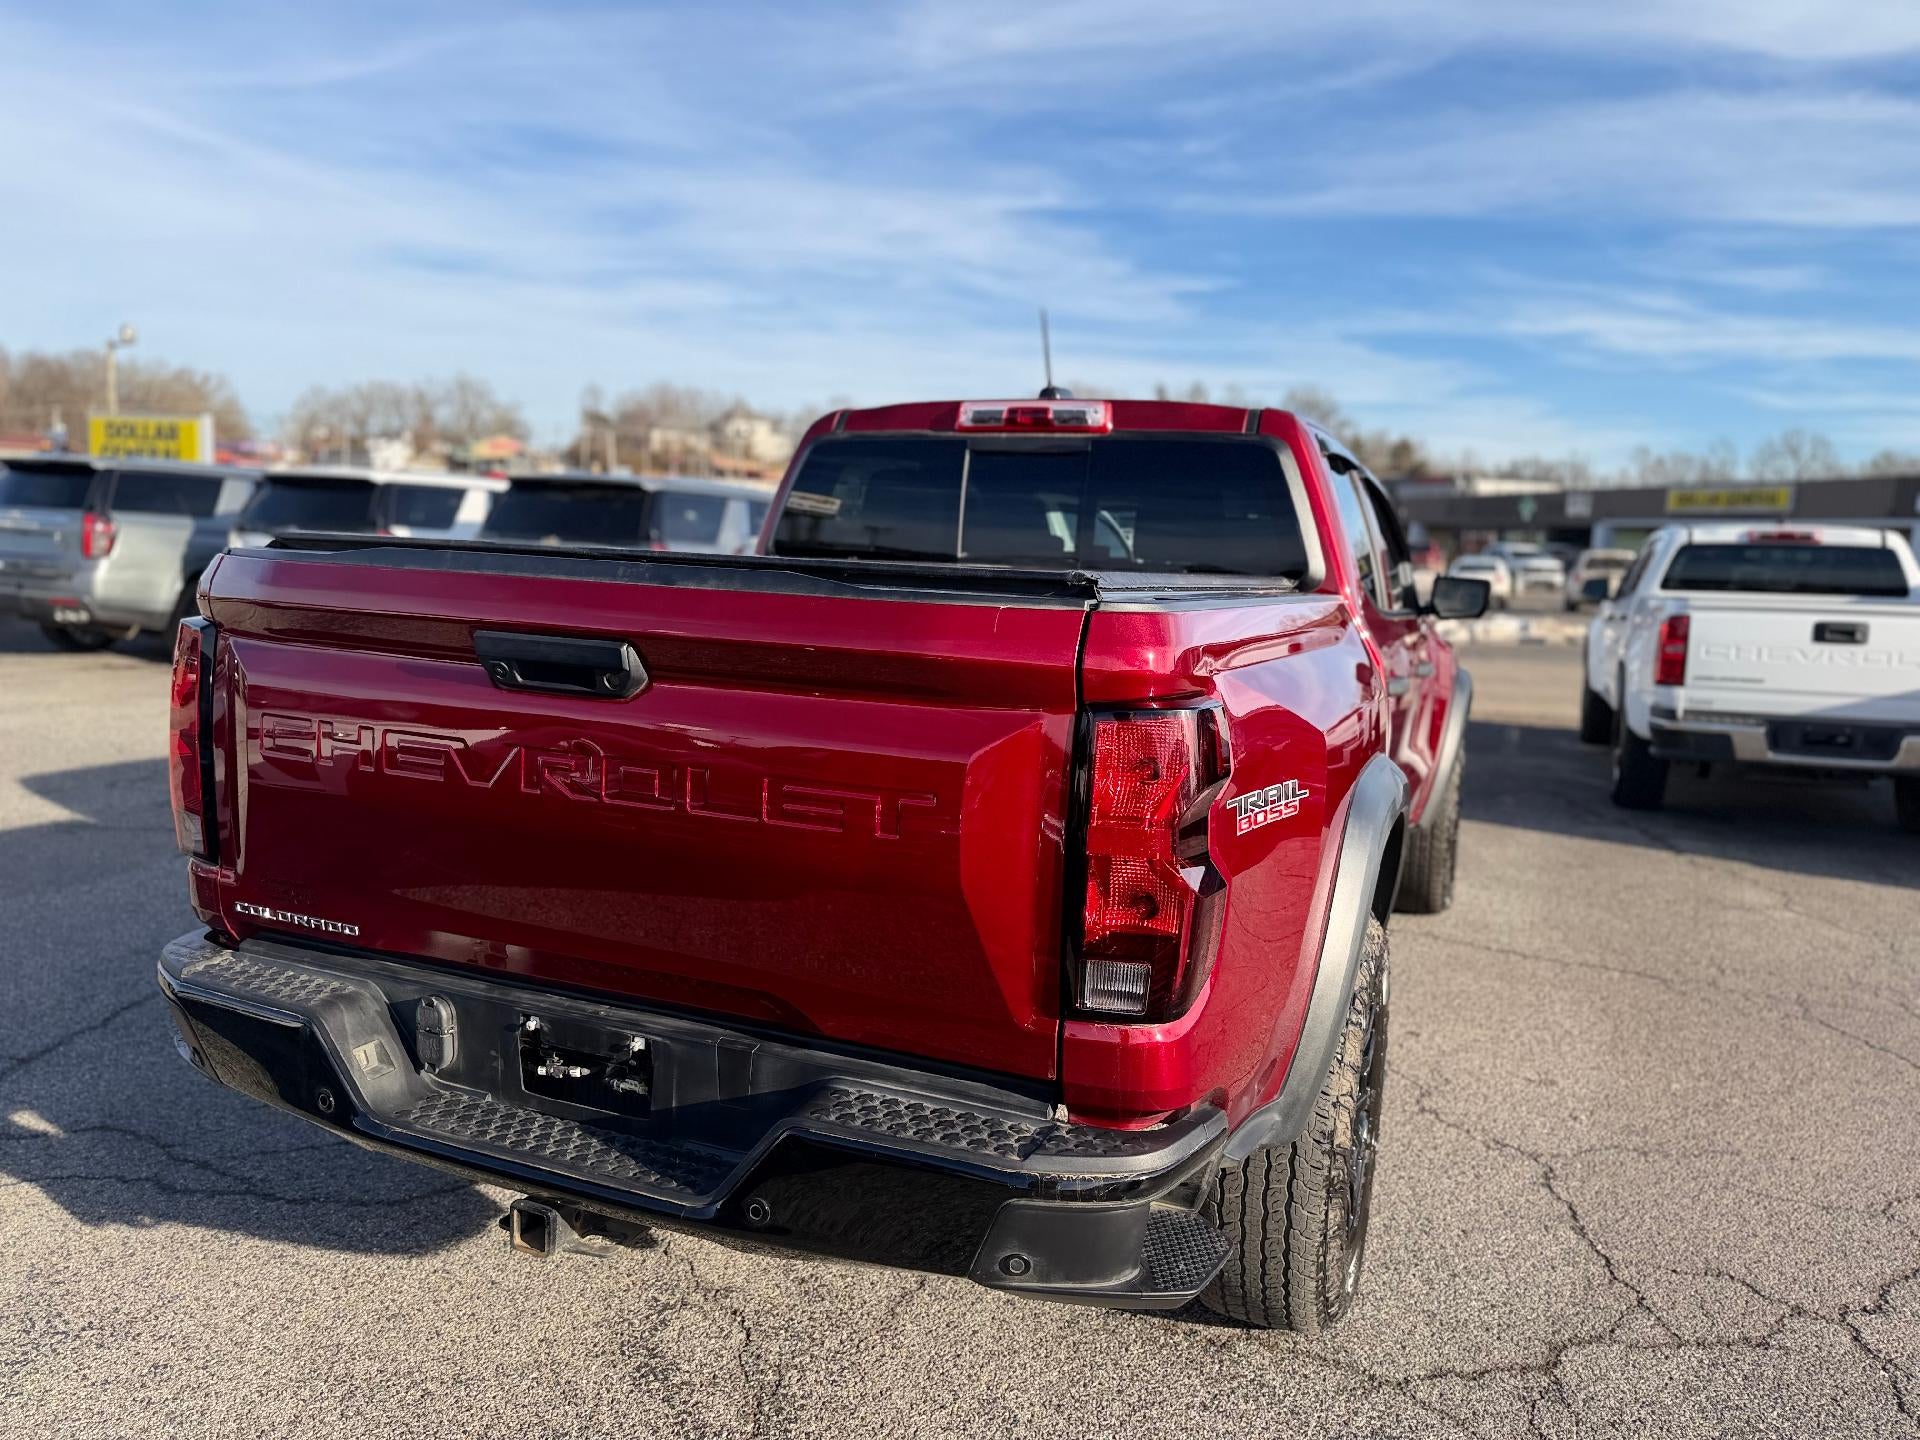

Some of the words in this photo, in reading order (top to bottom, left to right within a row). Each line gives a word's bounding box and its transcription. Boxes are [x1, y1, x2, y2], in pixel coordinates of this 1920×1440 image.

[104, 420, 179, 441] DOLLAR
[259, 712, 937, 839] CHEVROLET
[1226, 779, 1310, 817] TRAIL
[1236, 799, 1300, 836] BOSS
[234, 901, 359, 936] COLORADO
